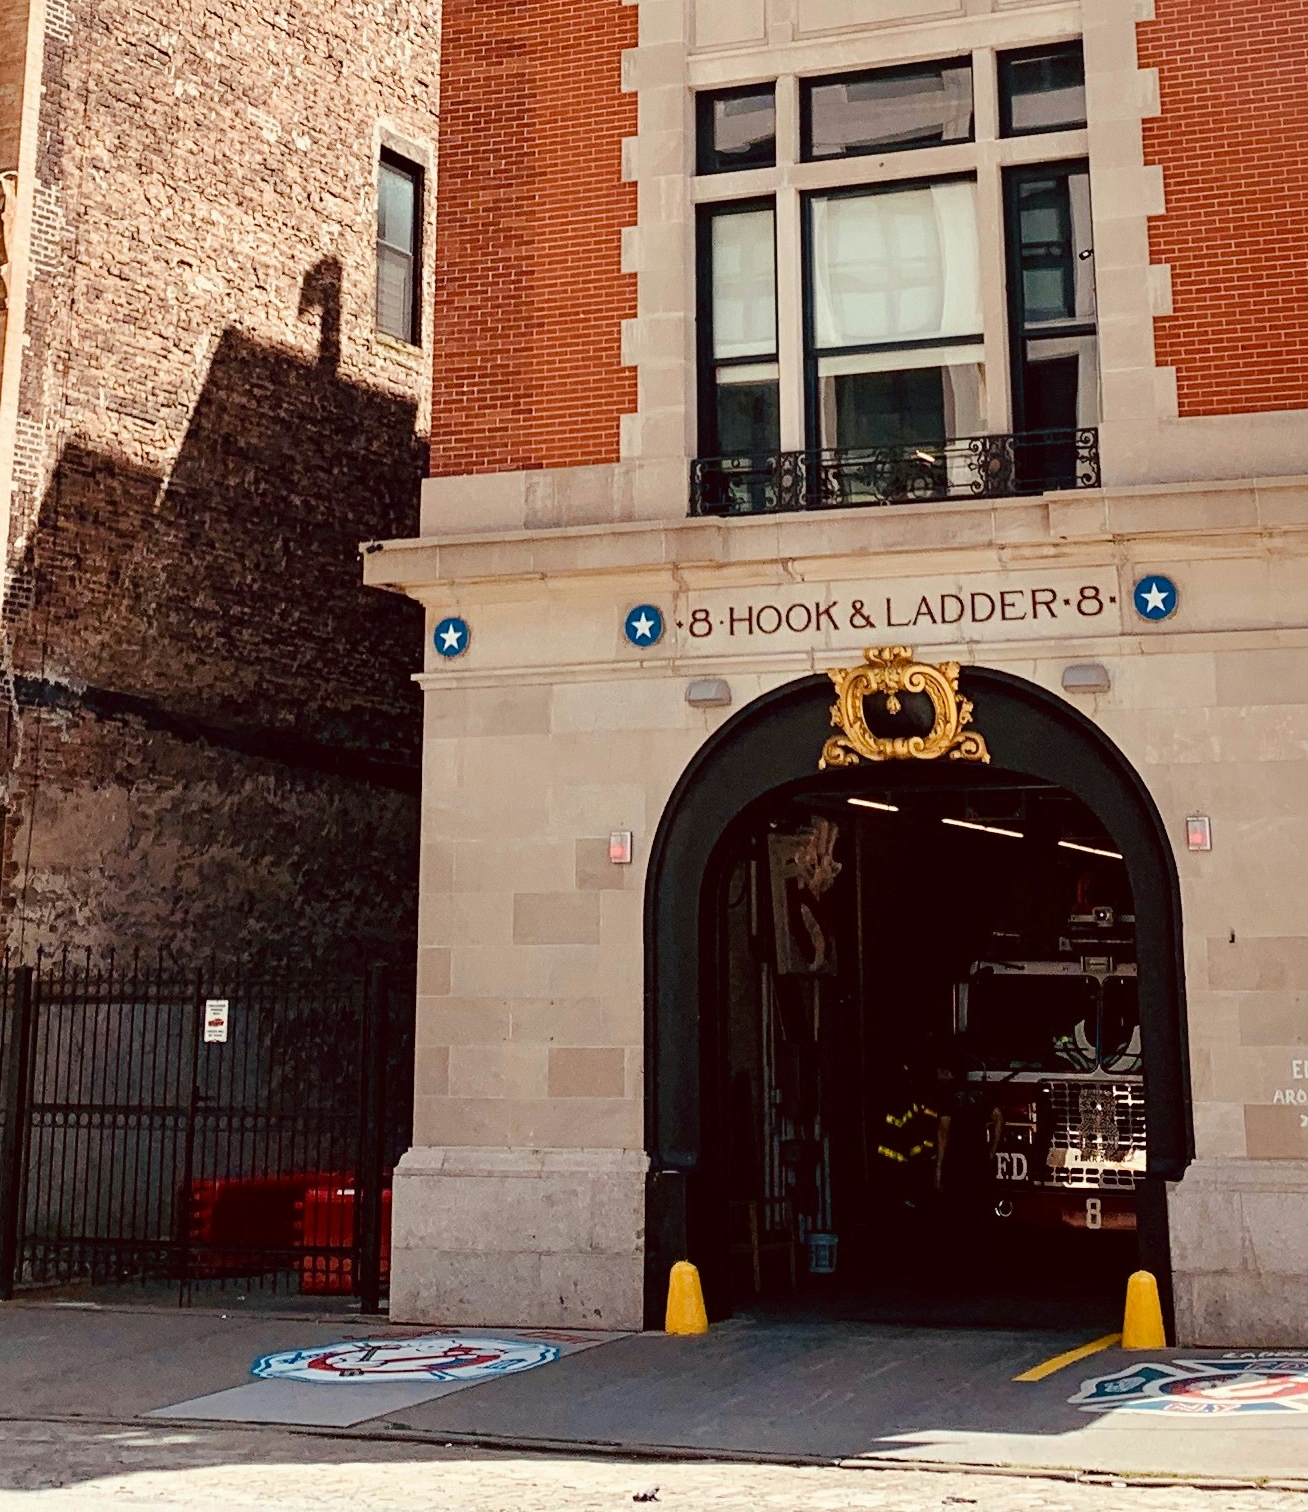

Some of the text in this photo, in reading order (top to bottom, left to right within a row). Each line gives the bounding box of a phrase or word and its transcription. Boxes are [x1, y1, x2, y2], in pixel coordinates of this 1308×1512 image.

[729, 601, 840, 636] HOOK
[849, 599, 876, 629] &
[885, 588, 1059, 627] LADDER
[1086, 1198, 1101, 1229] 8
